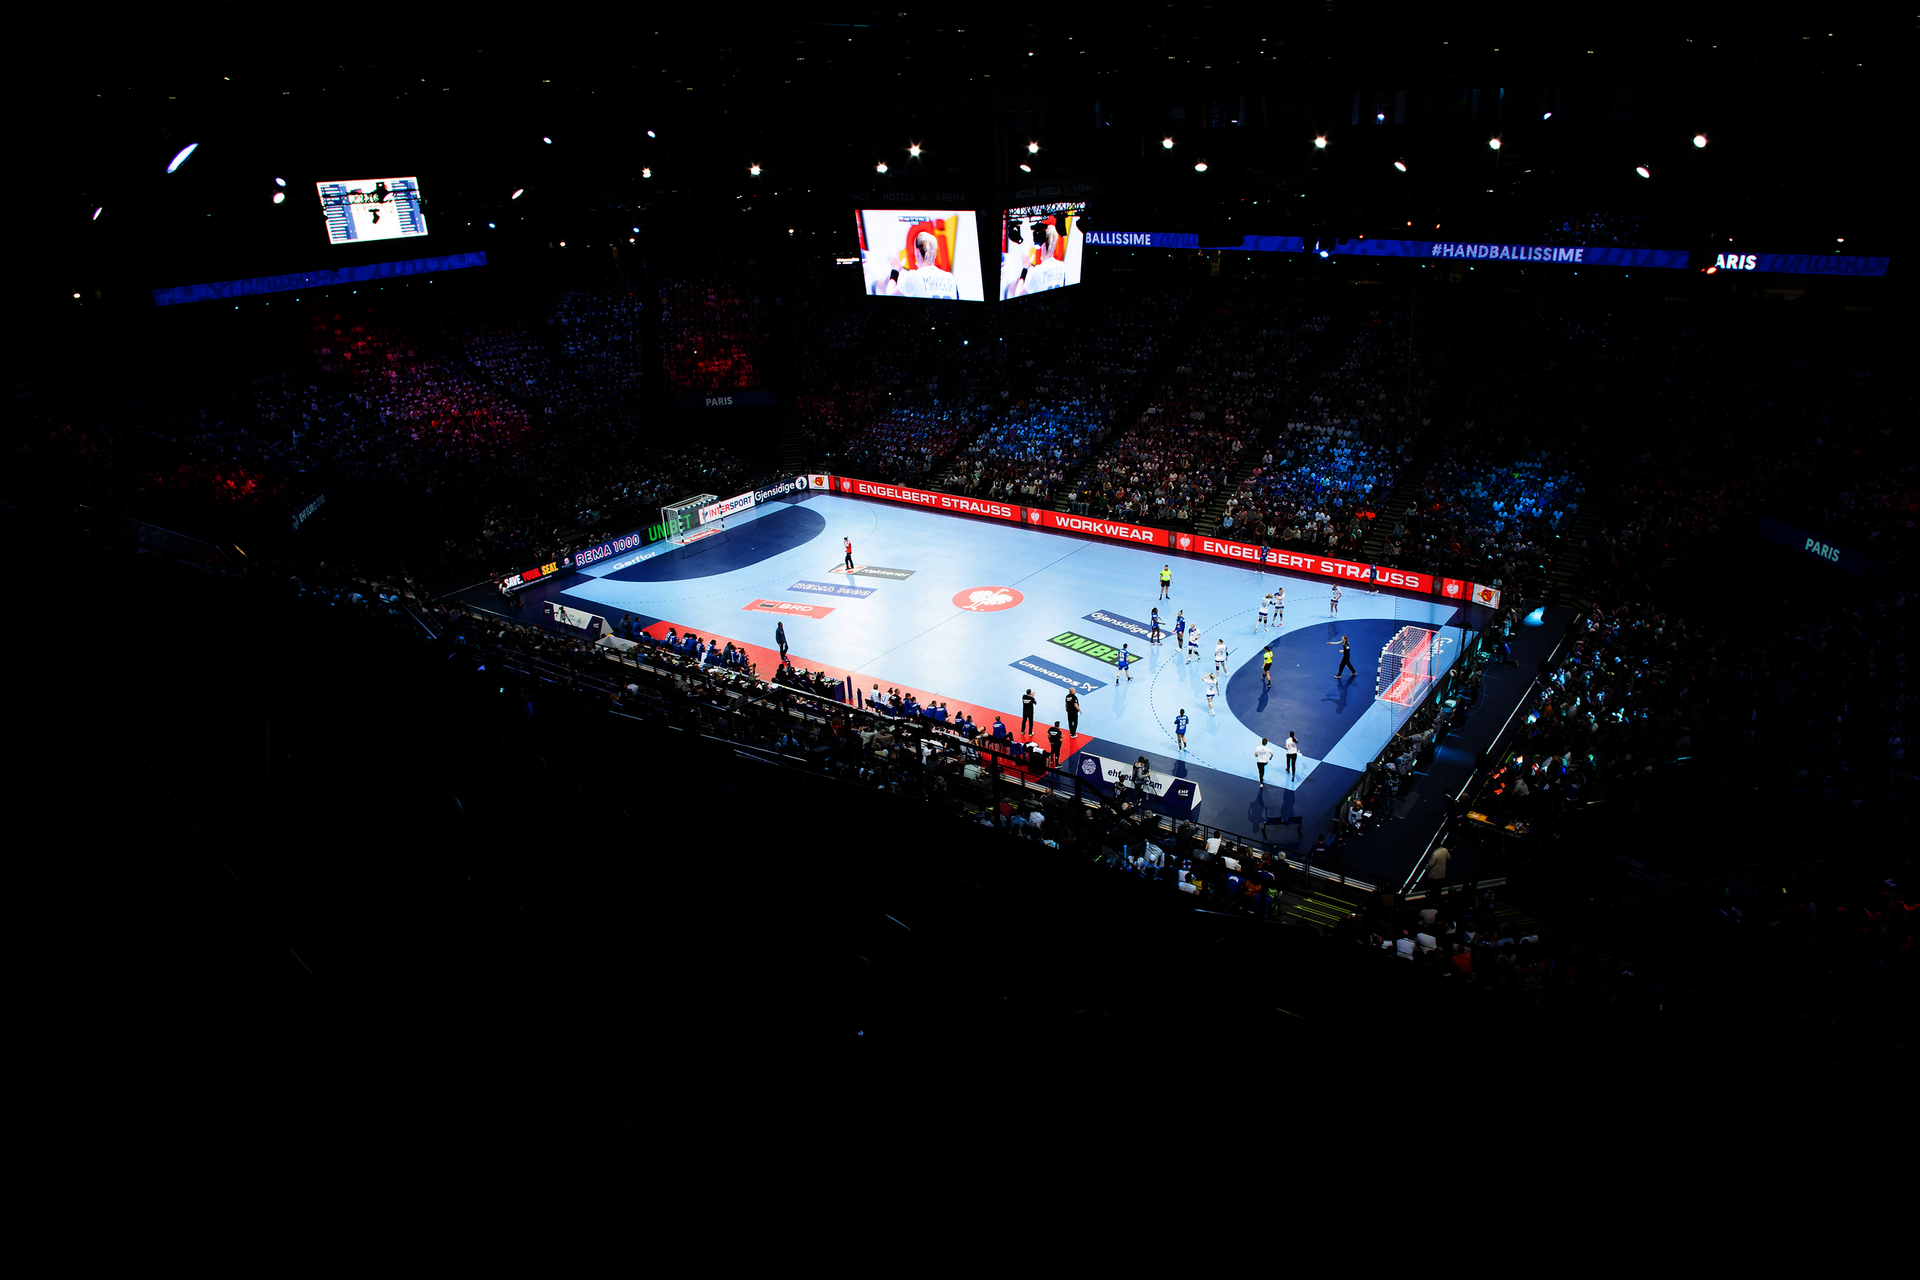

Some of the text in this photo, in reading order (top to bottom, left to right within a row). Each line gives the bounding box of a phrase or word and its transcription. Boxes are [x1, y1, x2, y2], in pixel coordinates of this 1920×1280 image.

[935, 192, 967, 202] ARENA
[1085, 232, 1151, 246] BALLISSIME
[1431, 243, 1584, 263] #HANDBALLISSIME
[1714, 253, 1758, 271] ARIS
[705, 396, 733, 407] PARIS
[754, 481, 795, 503] Gjensidige
[859, 482, 1012, 518] ENGELBERT STRAUSS
[708, 495, 753, 518] INTERSPORT
[648, 513, 692, 542] UNIBET
[1055, 515, 1154, 542] WORKWEAR
[575, 533, 641, 567] REMA 1000
[1804, 537, 1841, 563] PARIS
[1203, 540, 1420, 588] ENGELBERT STRAUSS
[792, 582, 835, 593] REMA
[778, 603, 814, 612] BRD
[1090, 611, 1149, 635] Gjensidige
[1052, 632, 1140, 666] UNIBE
[1018, 659, 1082, 687] GRUNDFOS
